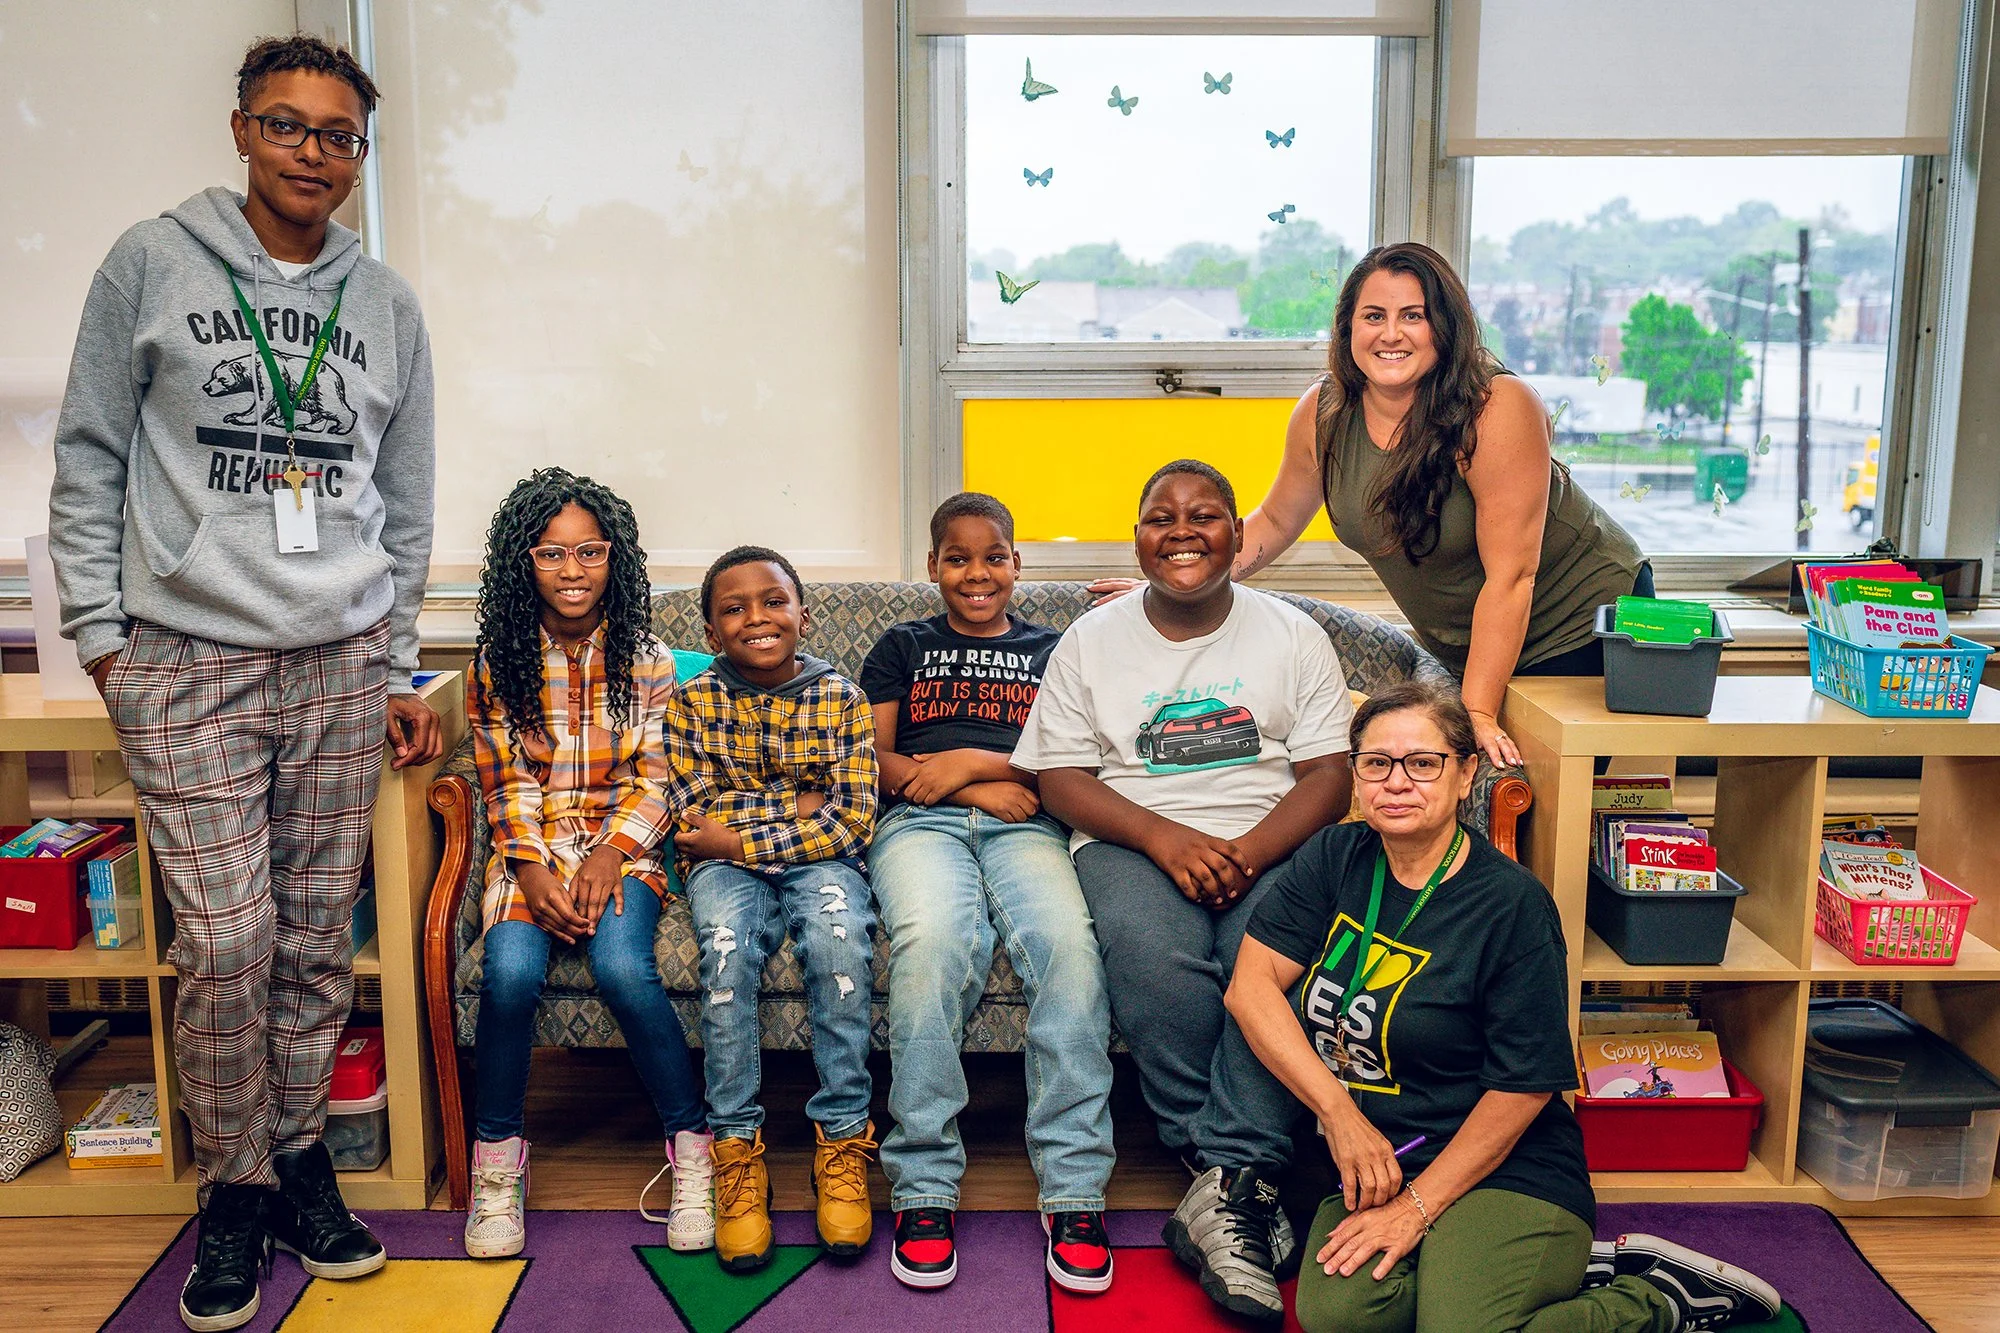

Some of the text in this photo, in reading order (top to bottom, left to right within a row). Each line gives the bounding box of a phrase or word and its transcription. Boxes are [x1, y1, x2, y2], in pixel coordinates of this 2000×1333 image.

[186, 307, 367, 373] CALFORNIA
[207, 451, 343, 499] REPUIC
[1863, 604, 1936, 624] Pam and
[1865, 618, 1893, 632] the
[1896, 622, 1939, 637] Clam
[966, 649, 1033, 671] READY
[910, 680, 944, 702] BUT
[951, 682, 971, 699] IS
[910, 700, 960, 723] READY
[968, 702, 1001, 722] FOR
[1614, 793, 1644, 805] Judy
[1442, 849, 1457, 867] SCHOOL
[1838, 862, 1914, 884] What's That,
[1850, 873, 1913, 891] Mittens?
[1307, 975, 1377, 1040] ES
[1600, 1039, 1703, 1066] Going Places
[79, 1136, 153, 1148] Sentence Building
